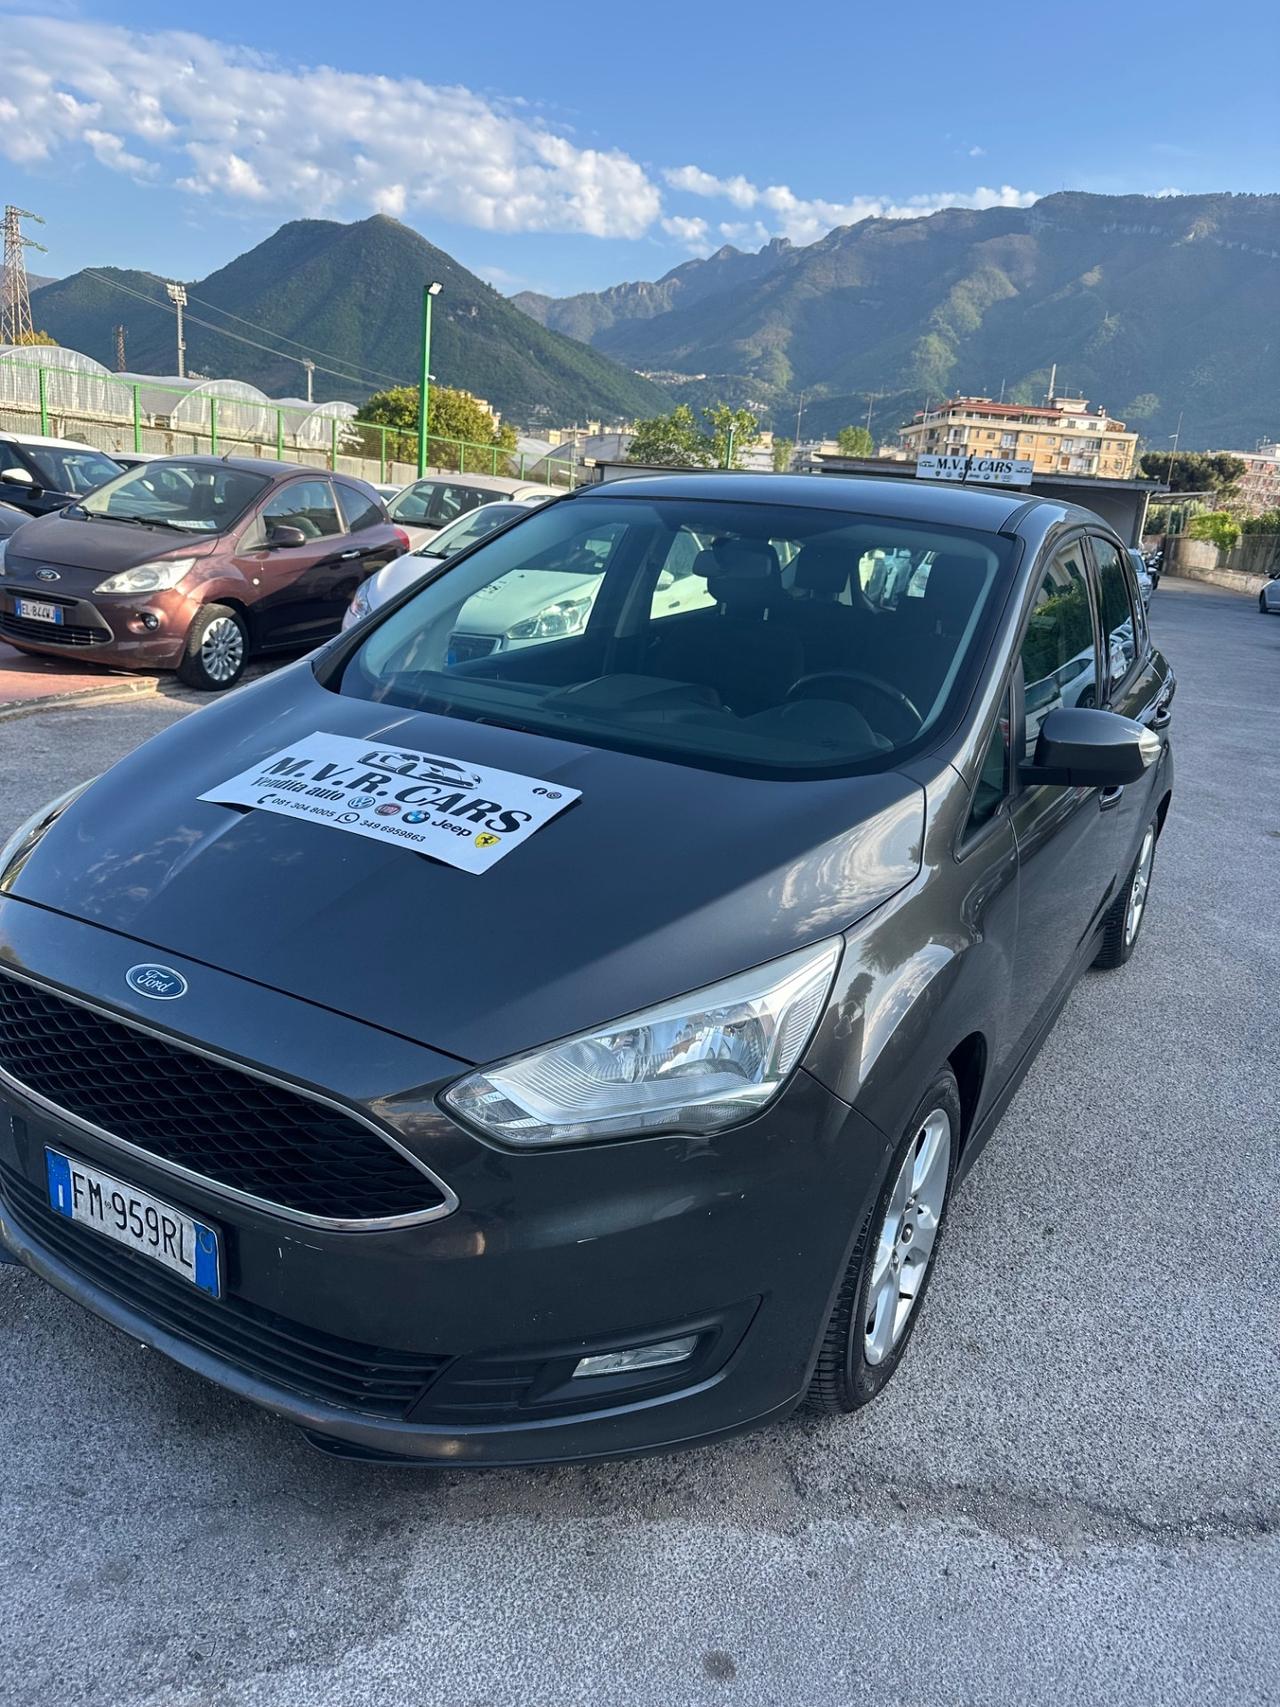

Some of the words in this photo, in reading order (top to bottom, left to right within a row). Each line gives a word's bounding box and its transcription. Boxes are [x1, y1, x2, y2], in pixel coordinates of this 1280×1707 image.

[250, 776, 308, 793] Vendita
[304, 786, 346, 801] auto
[271, 797, 291, 807] 081
[290, 802, 311, 811] 304
[309, 806, 337, 817] 8005
[359, 819, 381, 830] 349
[380, 825, 427, 843] 6959863
[431, 818, 473, 838] Jeep
[136, 969, 175, 993] Ford
